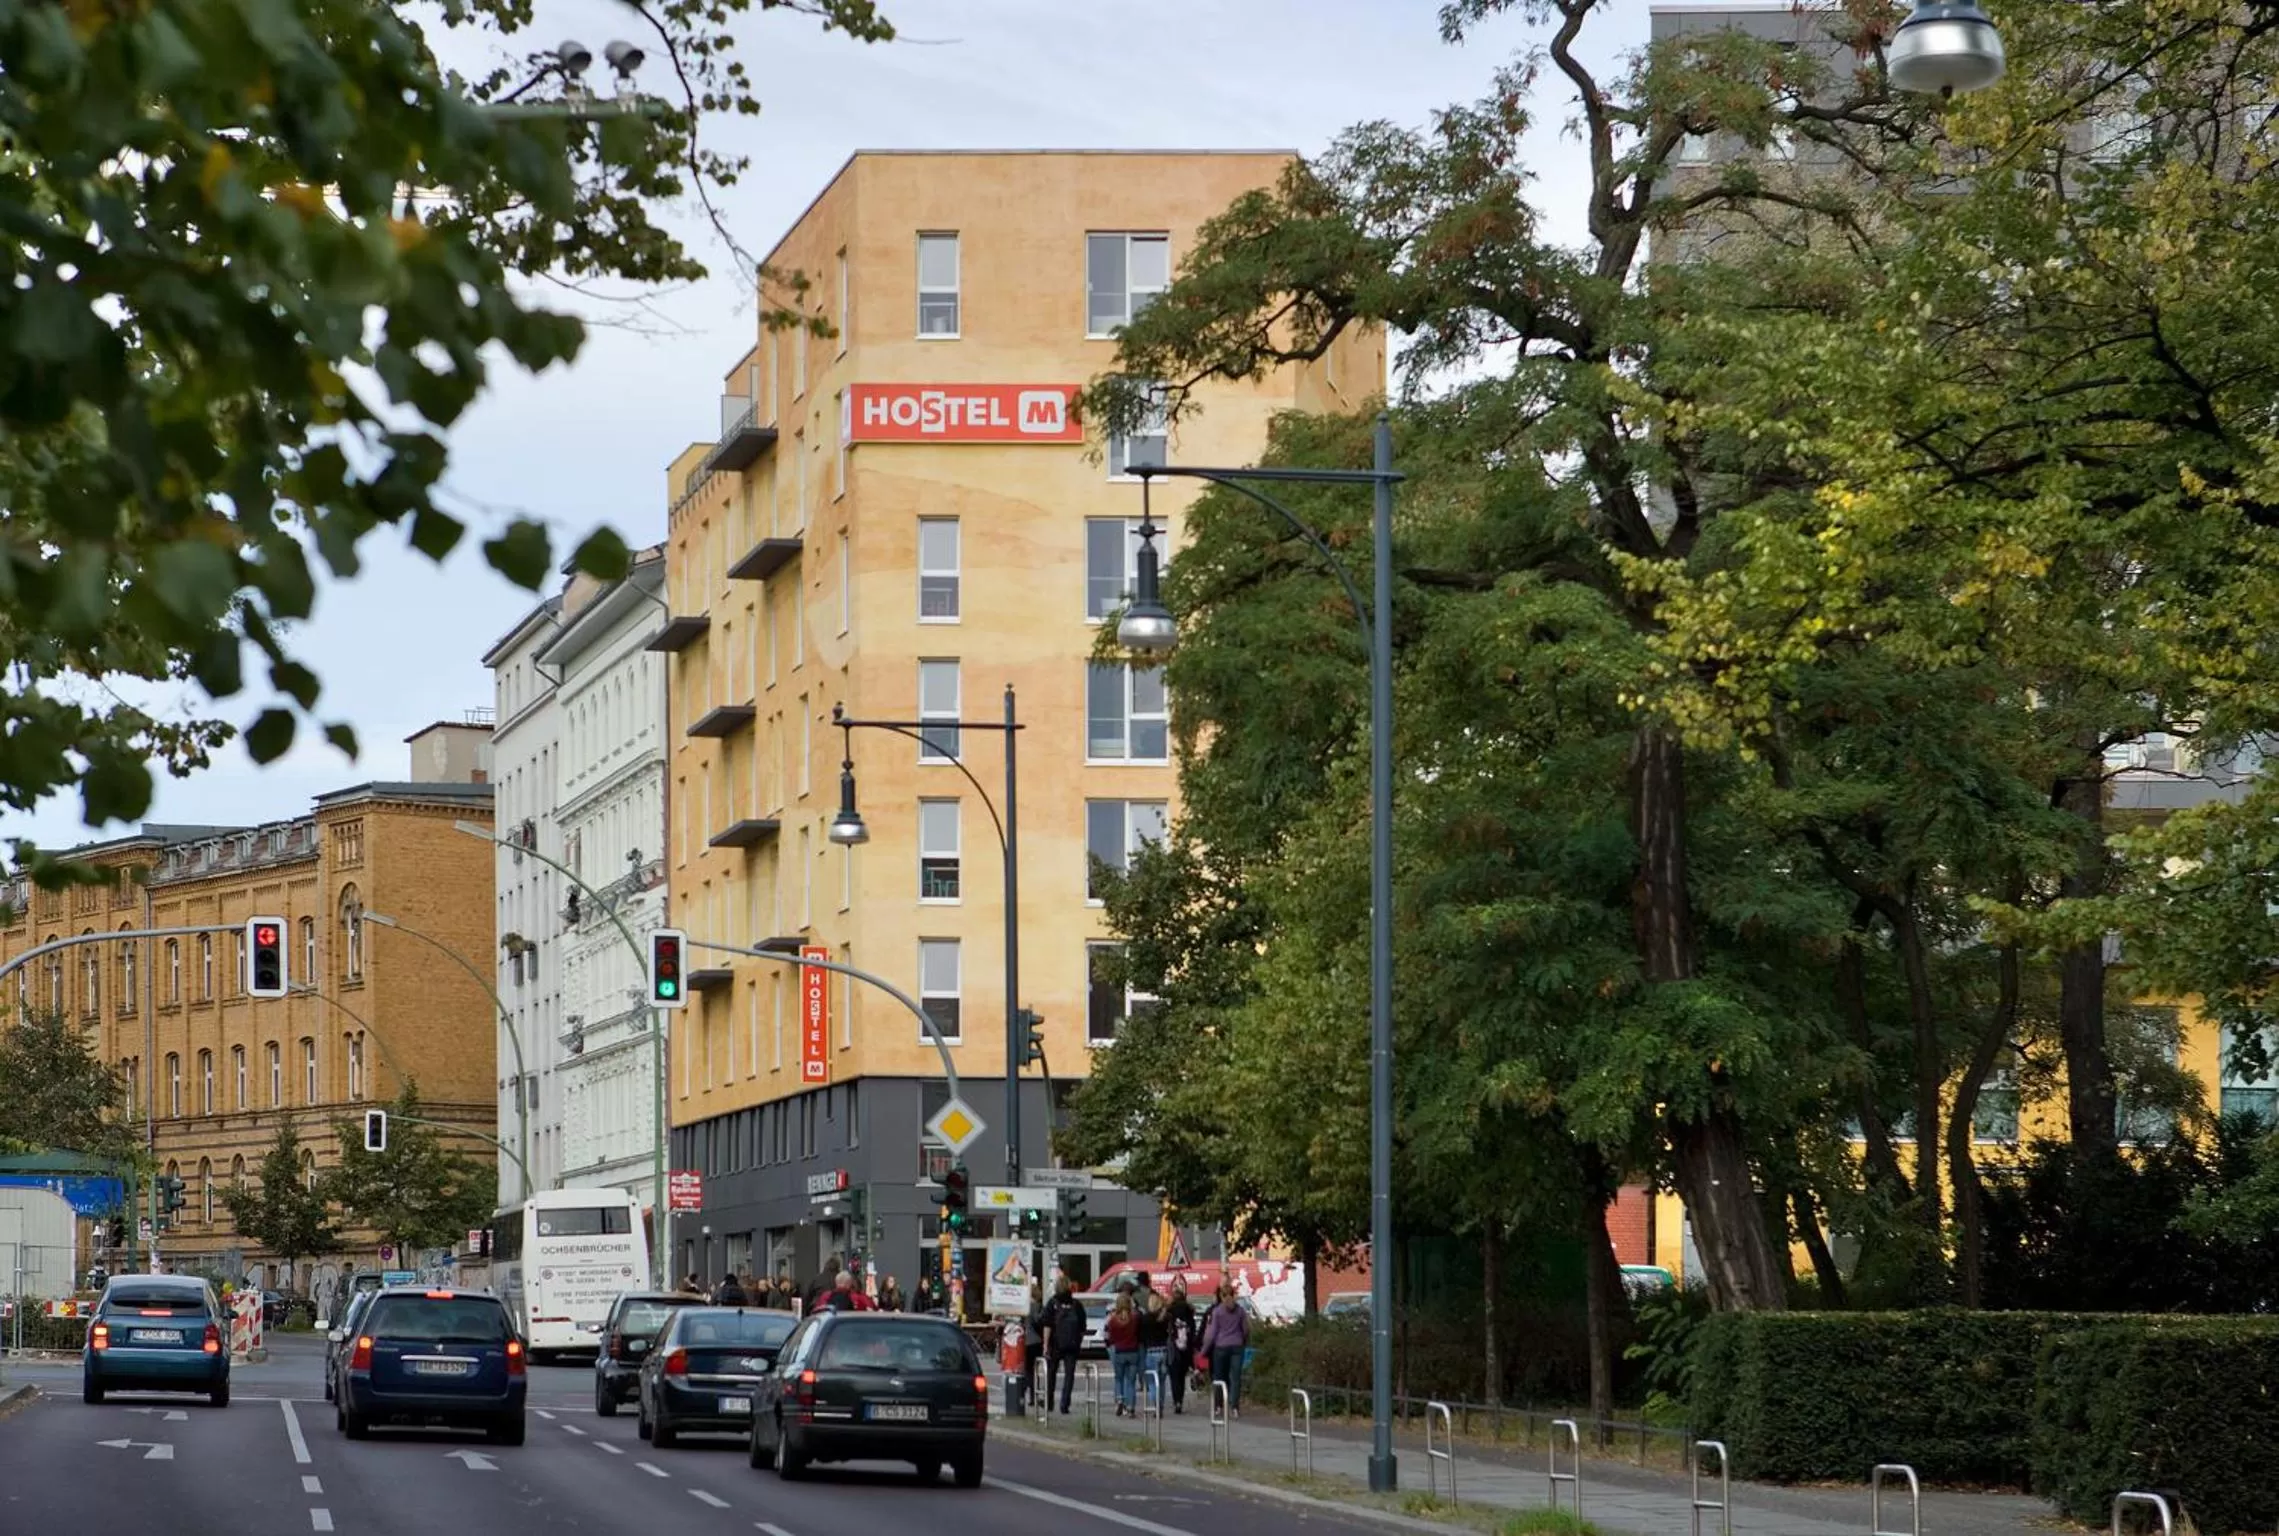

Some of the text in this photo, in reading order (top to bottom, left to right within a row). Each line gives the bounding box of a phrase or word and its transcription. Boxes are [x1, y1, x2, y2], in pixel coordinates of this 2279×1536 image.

[863, 395, 1060, 428] HOSTEL M
[809, 973, 821, 1055] HOSTEL
